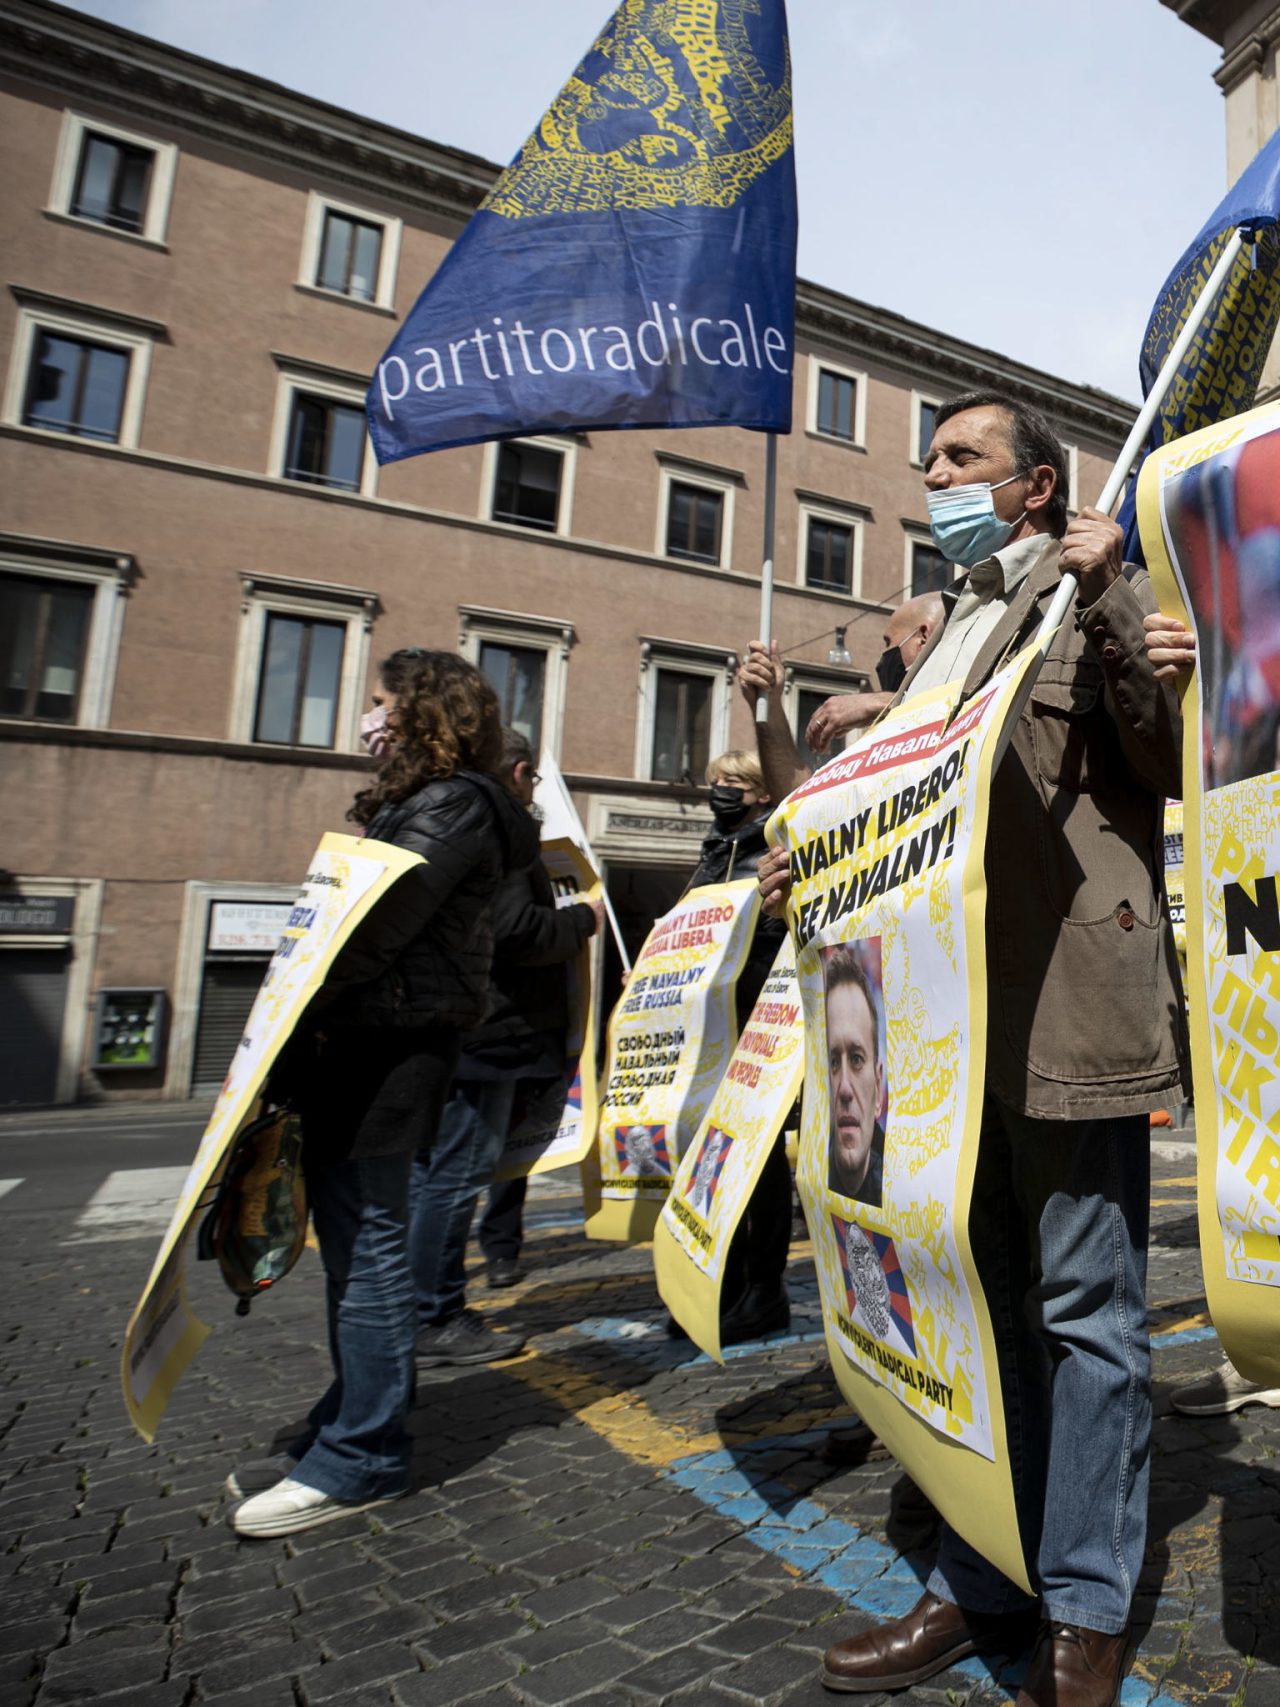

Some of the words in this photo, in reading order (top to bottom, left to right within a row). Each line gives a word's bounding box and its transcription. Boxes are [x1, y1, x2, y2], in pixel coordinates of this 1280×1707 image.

[791, 808, 872, 884] AVALNY
[878, 738, 970, 839] LIBERO!
[820, 806, 957, 930] NAVALNY!
[688, 905, 734, 928] LIBERO
[671, 928, 713, 950] LIBERA
[649, 966, 706, 990] NAVALNY
[643, 989, 682, 1010] RUSSIA
[876, 1345, 917, 1390] RADICAL
[917, 1370, 953, 1411] PARTY
